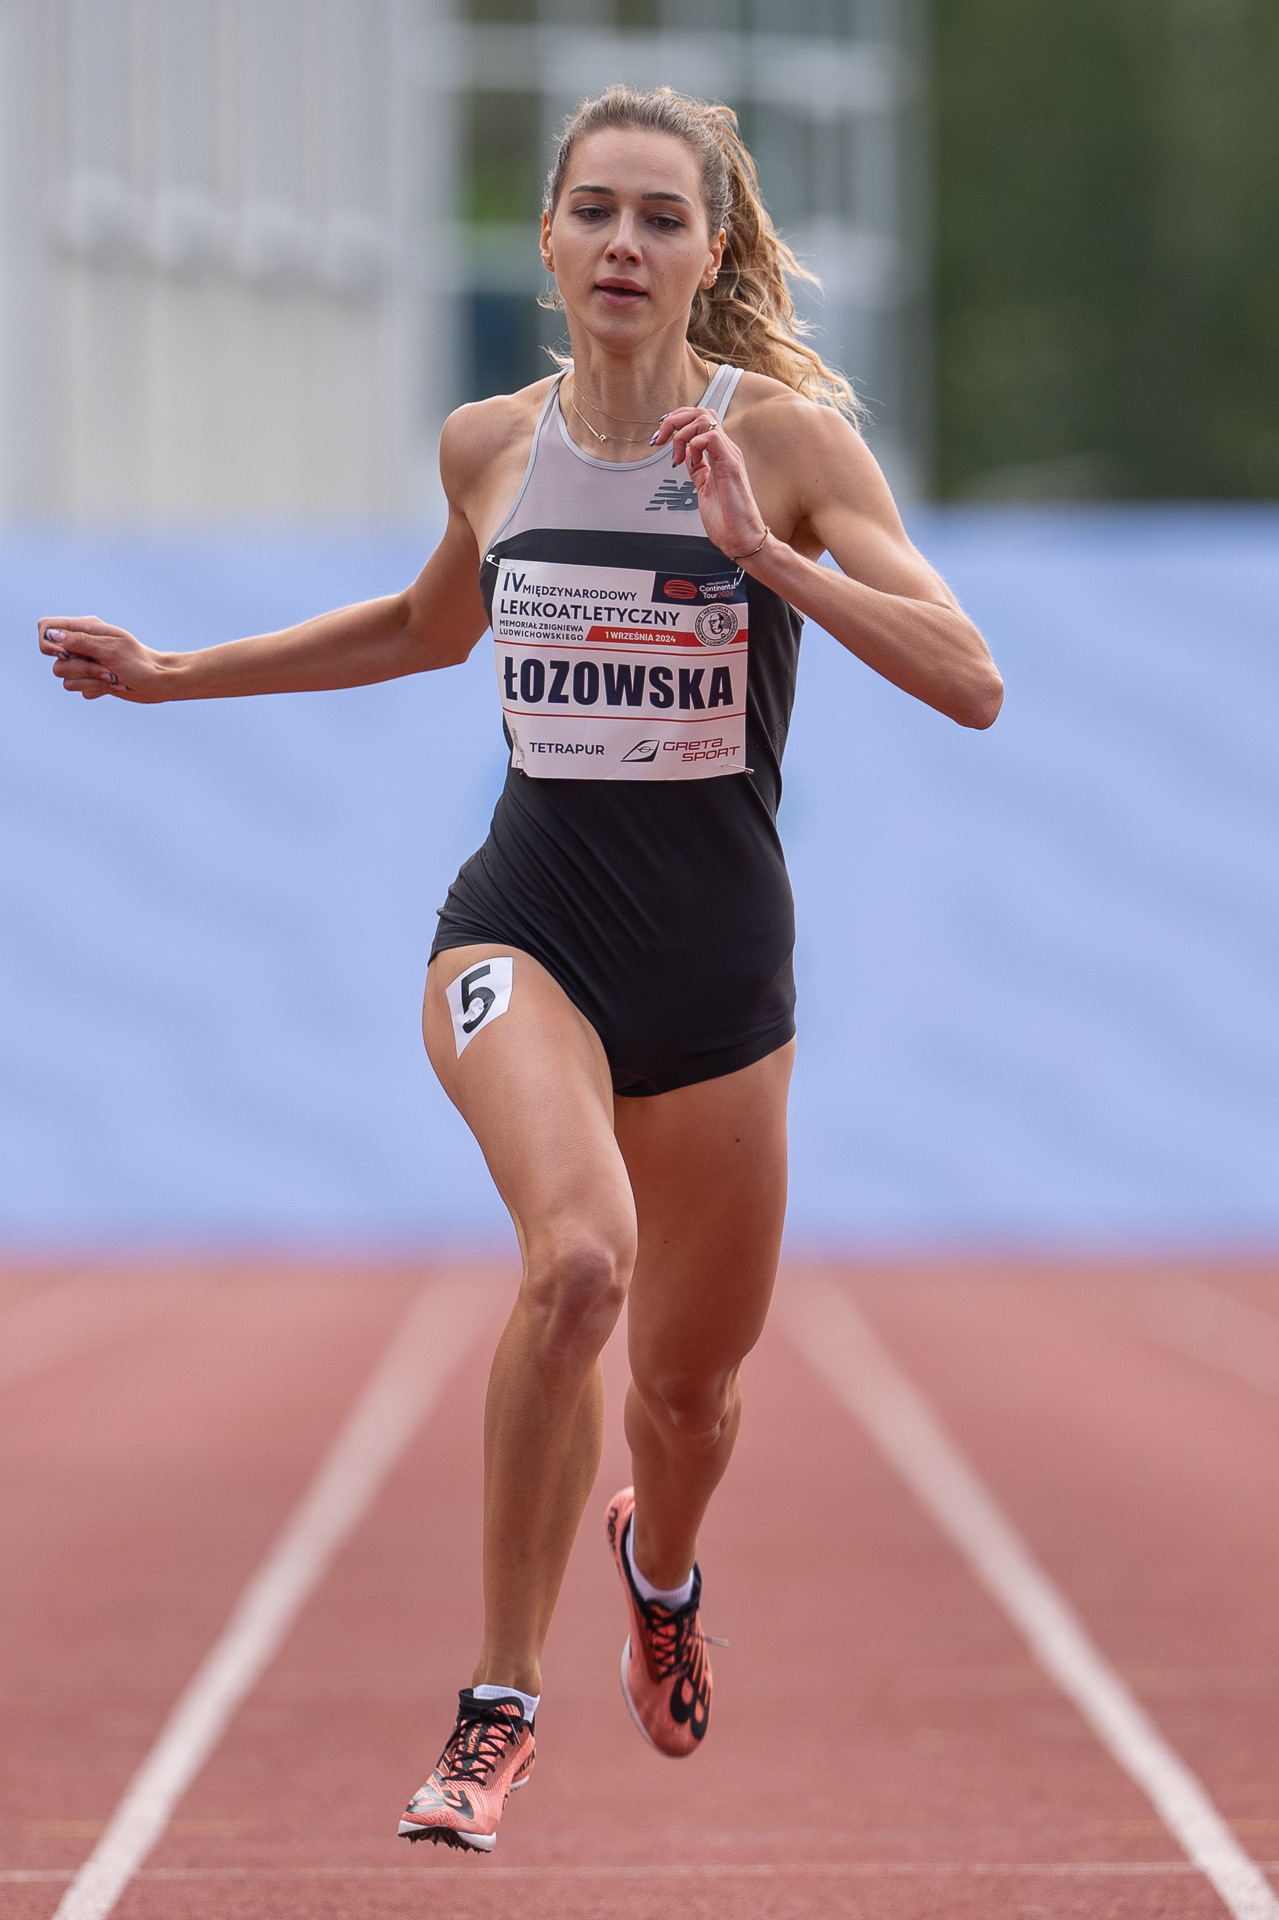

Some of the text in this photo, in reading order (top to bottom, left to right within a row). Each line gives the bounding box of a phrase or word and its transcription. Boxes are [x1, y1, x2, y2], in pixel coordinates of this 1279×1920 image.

[503, 572, 637, 602] IV MIĘDZYNARODOWY
[500, 598, 680, 626] LEKKOATLETYCZNY
[499, 619, 584, 633] MEMORIAŁ ZBIGNIEWA
[499, 628, 584, 641] LUDWICHOWSKIEGO
[605, 631, 676, 643] 1 WRZEŚNIA 2024
[504, 656, 734, 711] ŁOZOWSKA
[529, 741, 605, 756] TETRAPUR
[681, 745, 740, 762] SPORT
[461, 964, 496, 1034] 5
